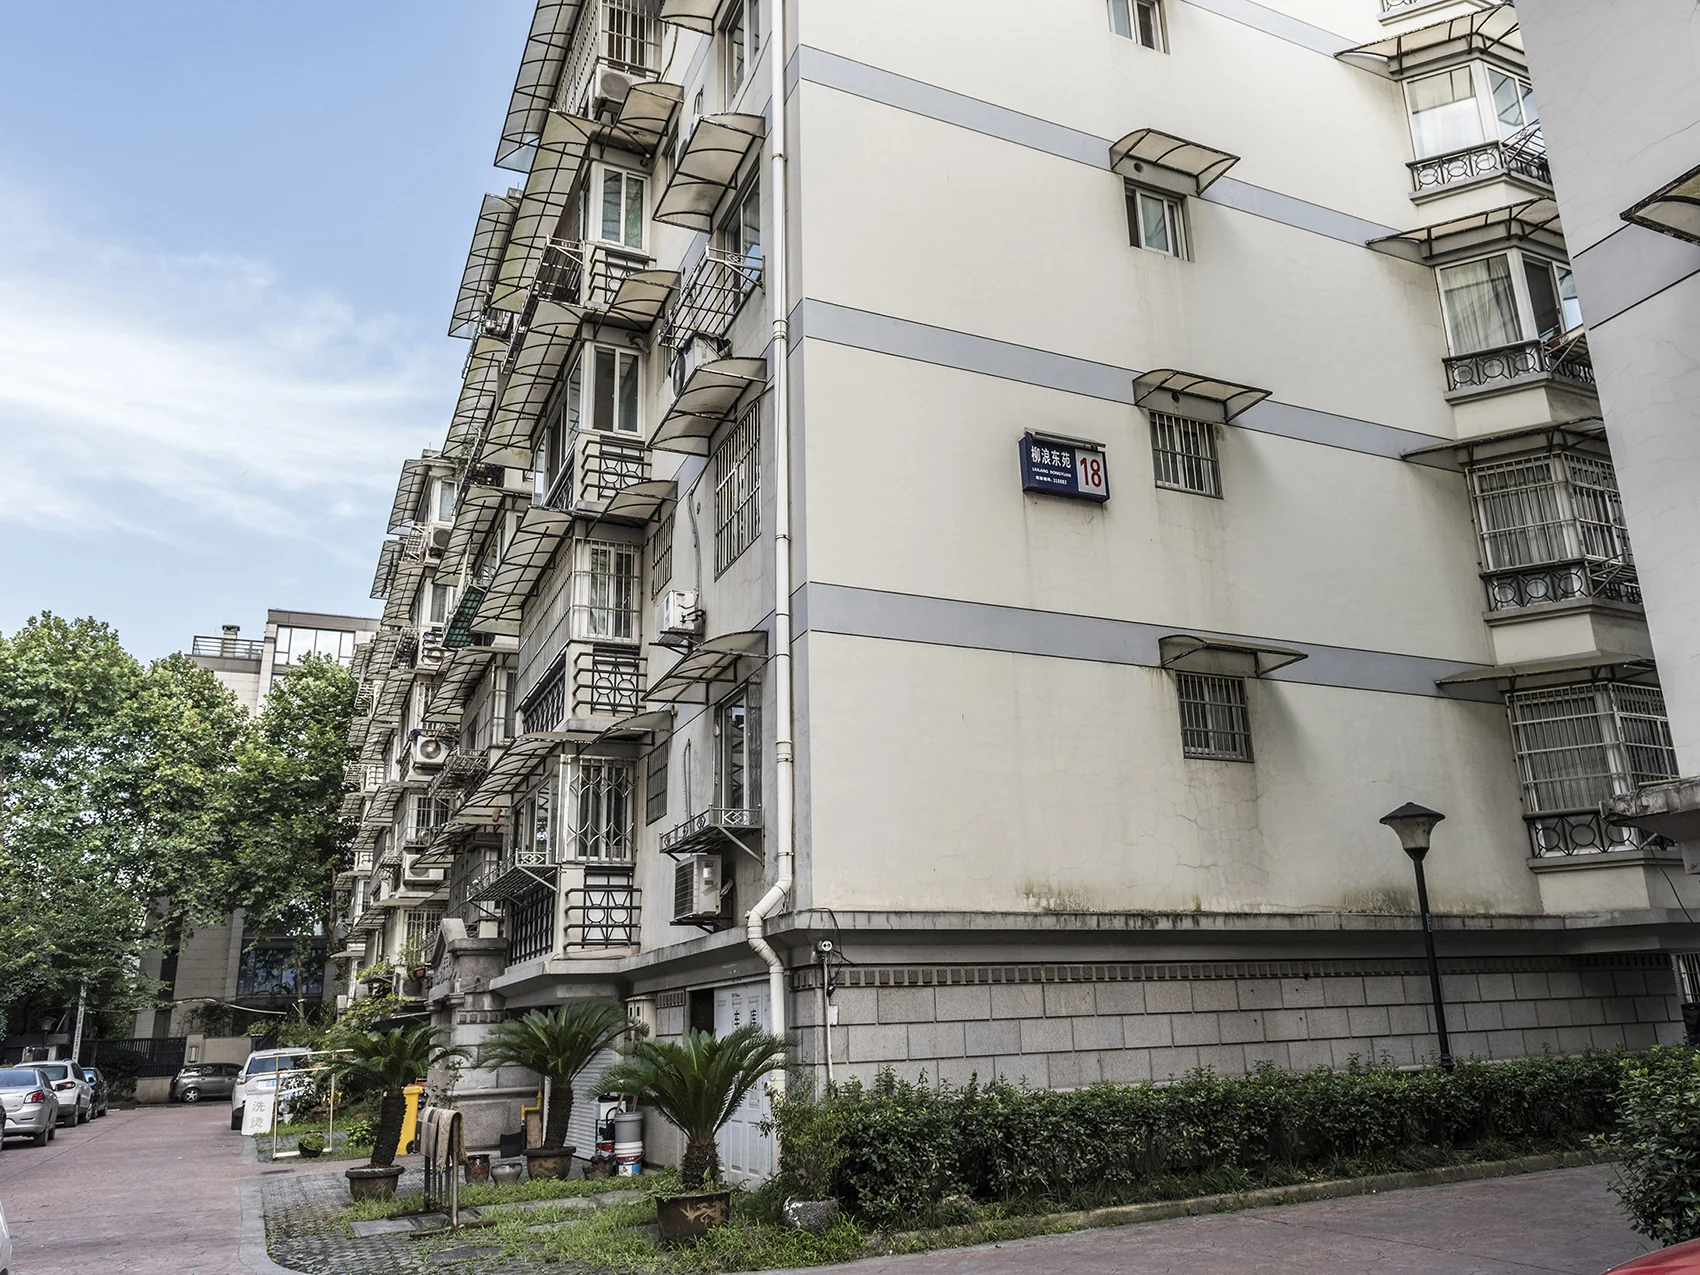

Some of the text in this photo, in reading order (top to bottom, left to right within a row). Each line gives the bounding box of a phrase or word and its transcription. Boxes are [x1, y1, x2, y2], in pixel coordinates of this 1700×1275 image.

[1031, 445, 1072, 469] 柳浪东苑
[1080, 457, 1102, 488] 18
